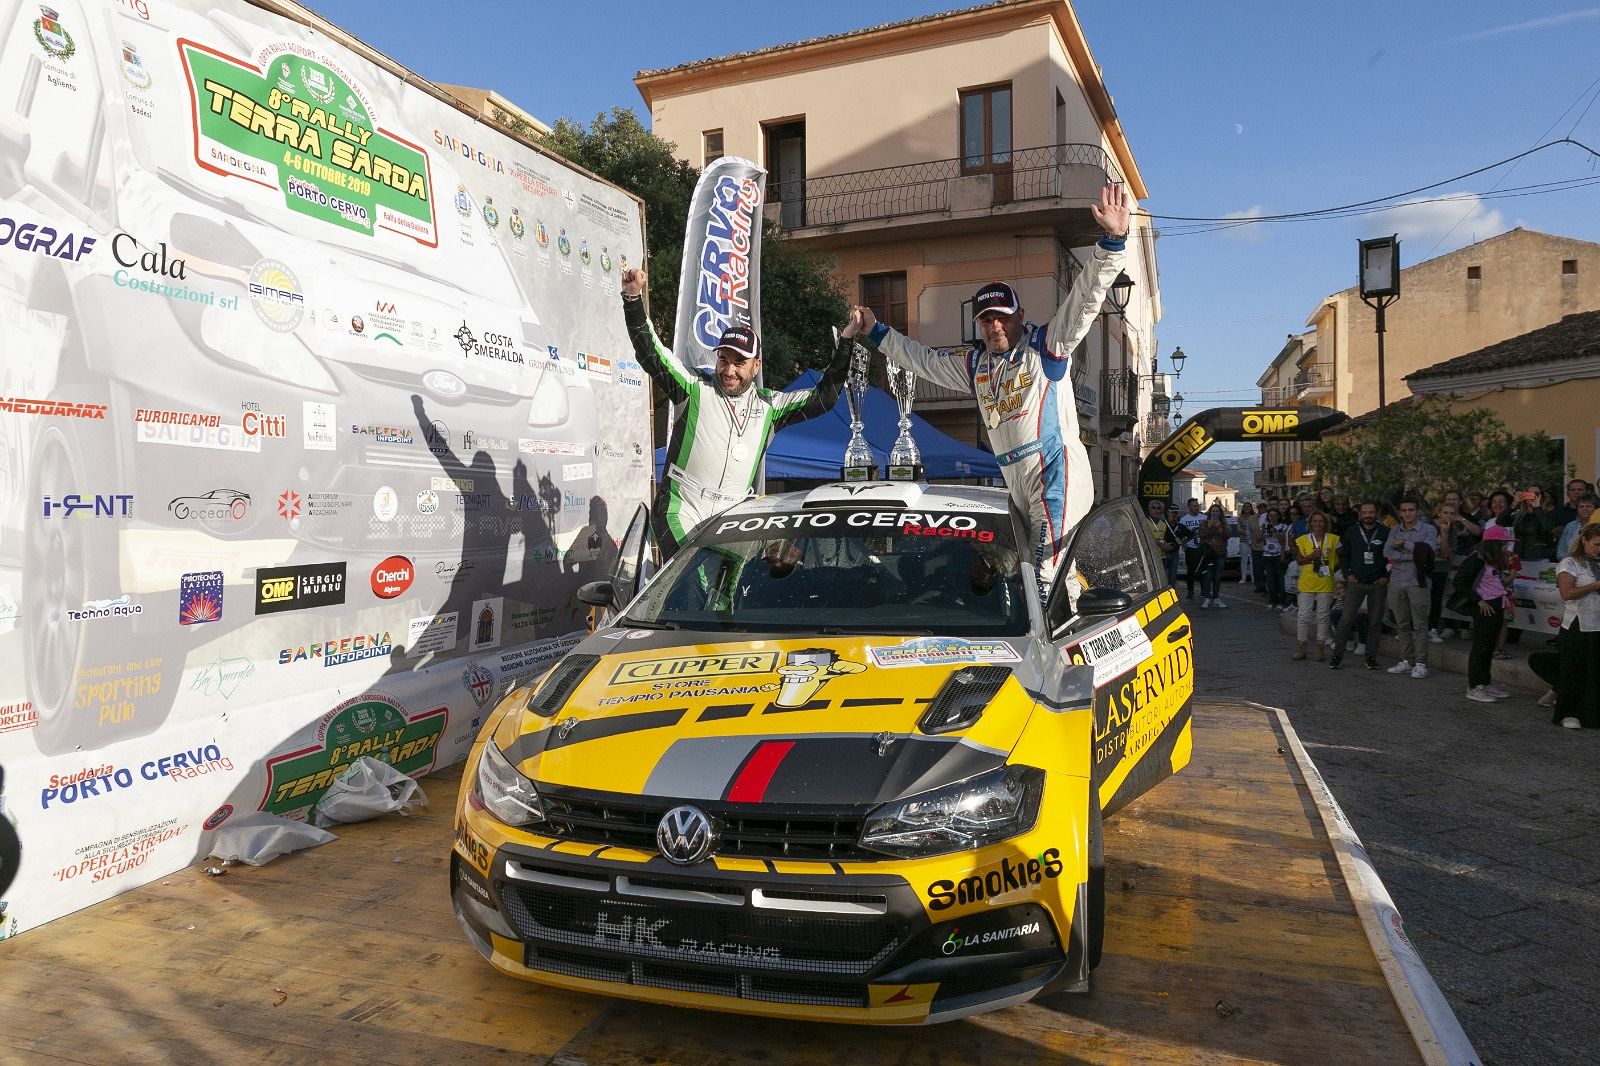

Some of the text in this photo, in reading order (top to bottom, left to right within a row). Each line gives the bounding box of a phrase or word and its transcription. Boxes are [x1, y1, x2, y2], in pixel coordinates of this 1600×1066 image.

[290, 97, 374, 147] RALLY
[204, 77, 428, 201] TERRA SARDA
[211, 147, 267, 177] SARDEGNA
[434, 129, 505, 175] SARDEGNA
[283, 150, 371, 196] 4-6 OTTOBRE 2019
[288, 181, 367, 219] PORTO CERVO
[720, 178, 760, 309] Racing
[112, 233, 186, 280] Cala
[693, 175, 741, 350] CERVO
[113, 269, 214, 306] Costruzioni
[219, 295, 239, 311] srl
[249, 282, 303, 304] GIMAR
[978, 293, 989, 302] PORTO
[484, 332, 513, 348] COSTA
[474, 344, 524, 365] SMERALDA
[241, 401, 262, 412] HOTEL
[135, 408, 222, 429] EURORICAMBI
[242, 412, 287, 438] Citti
[1242, 415, 1299, 434] OMP
[352, 424, 413, 438] SARDEGNA
[377, 435, 412, 445] INFOPOINT
[1161, 426, 1207, 468] OMP
[1143, 484, 1170, 495] OMP
[715, 511, 977, 536] PORTO CERVO
[902, 523, 994, 542] Racing
[183, 573, 222, 583] PIROTECNICA
[183, 580, 222, 589] LAZIALE
[302, 573, 343, 586] SERGIO
[376, 567, 410, 583] Cherchi
[261, 580, 294, 599] OMP
[303, 583, 341, 595] MURRU
[68, 605, 142, 621] Techno Aqua
[279, 631, 392, 664] SARDEGNA
[325, 645, 390, 667] INFOPOINT
[501, 650, 525, 662] REGIONE
[553, 643, 561, 651] DE
[501, 661, 525, 673] REGIONE
[627, 656, 763, 679] CLIPPER
[597, 685, 761, 706] TEMPIO PAUSANIA
[651, 679, 711, 690] STORE
[317, 694, 409, 742] COPPA RALLY SARDEGNA RALLY CUP
[346, 726, 406, 759] RALLY
[1096, 706, 1160, 764] DISTRIBUTORI
[41, 744, 221, 809] PORTO CERVO
[49, 763, 114, 789] Scuderia
[167, 755, 234, 783] Racing
[274, 763, 350, 804] TERR
[74, 839, 113, 856] CAMPAGNA
[84, 850, 102, 860] ALLA
[102, 838, 136, 854] SICUREZZA
[80, 854, 109, 875] PER
[111, 848, 129, 864] LA
[964, 922, 1040, 946] LA SANITARIA
